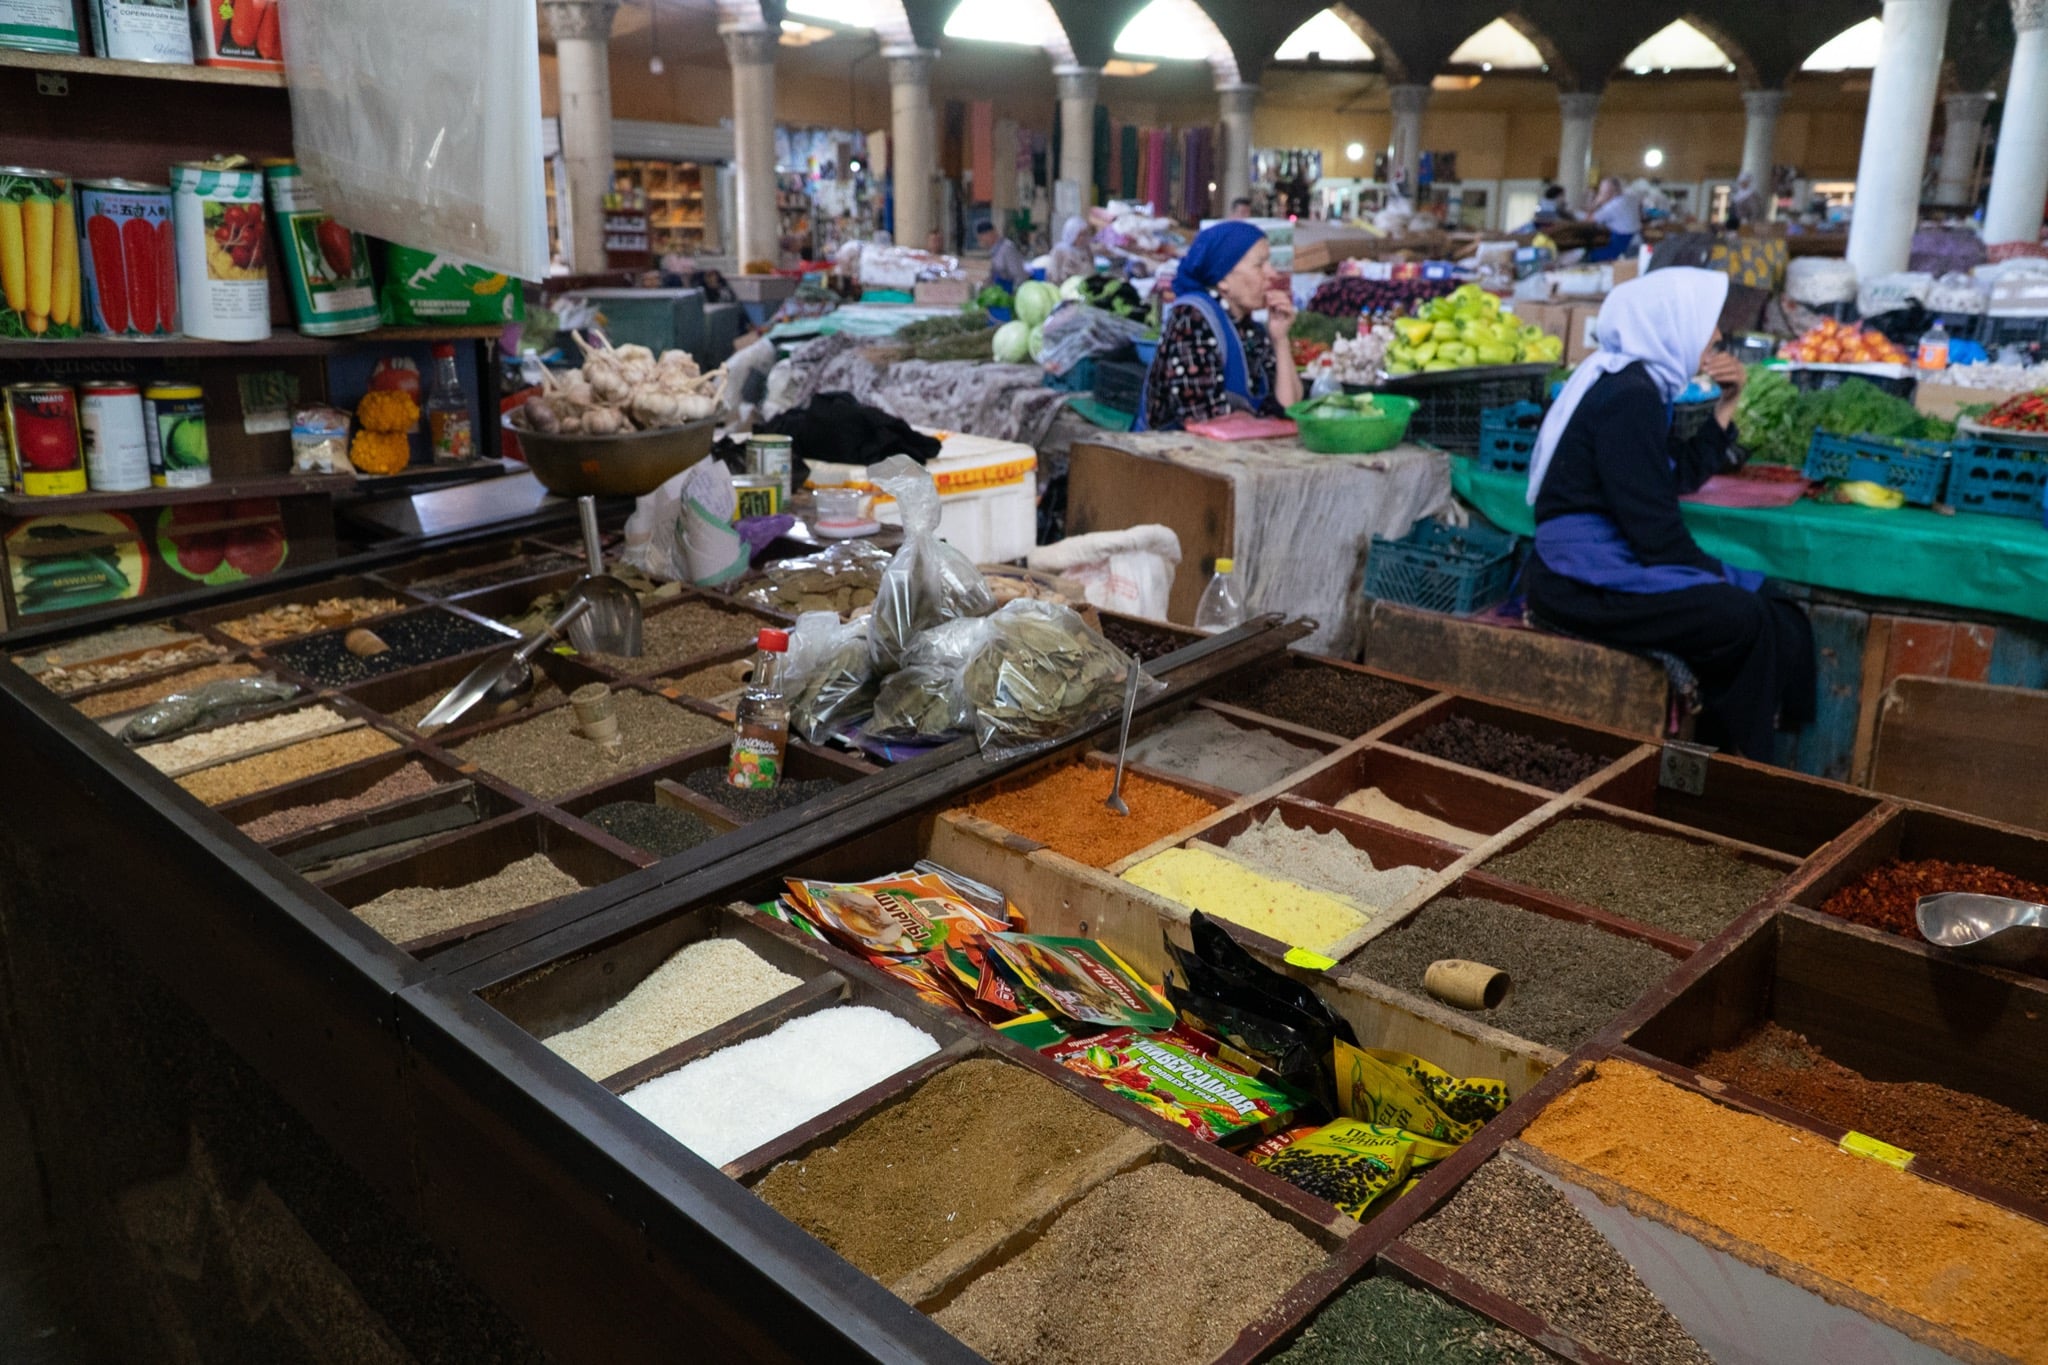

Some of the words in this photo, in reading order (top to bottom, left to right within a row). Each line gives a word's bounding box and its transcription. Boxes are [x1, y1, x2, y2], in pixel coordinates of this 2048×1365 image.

[120, 9, 169, 19] COPENHAGEN
[30, 394, 64, 404] TOMATO
[1093, 968, 1143, 1010] Шурпы
[1136, 1056, 1147, 1067] 15
[1134, 1040, 1259, 1117] УНИВЕРСАЛЬНАЯ
[1376, 1152, 1395, 1166] 50
